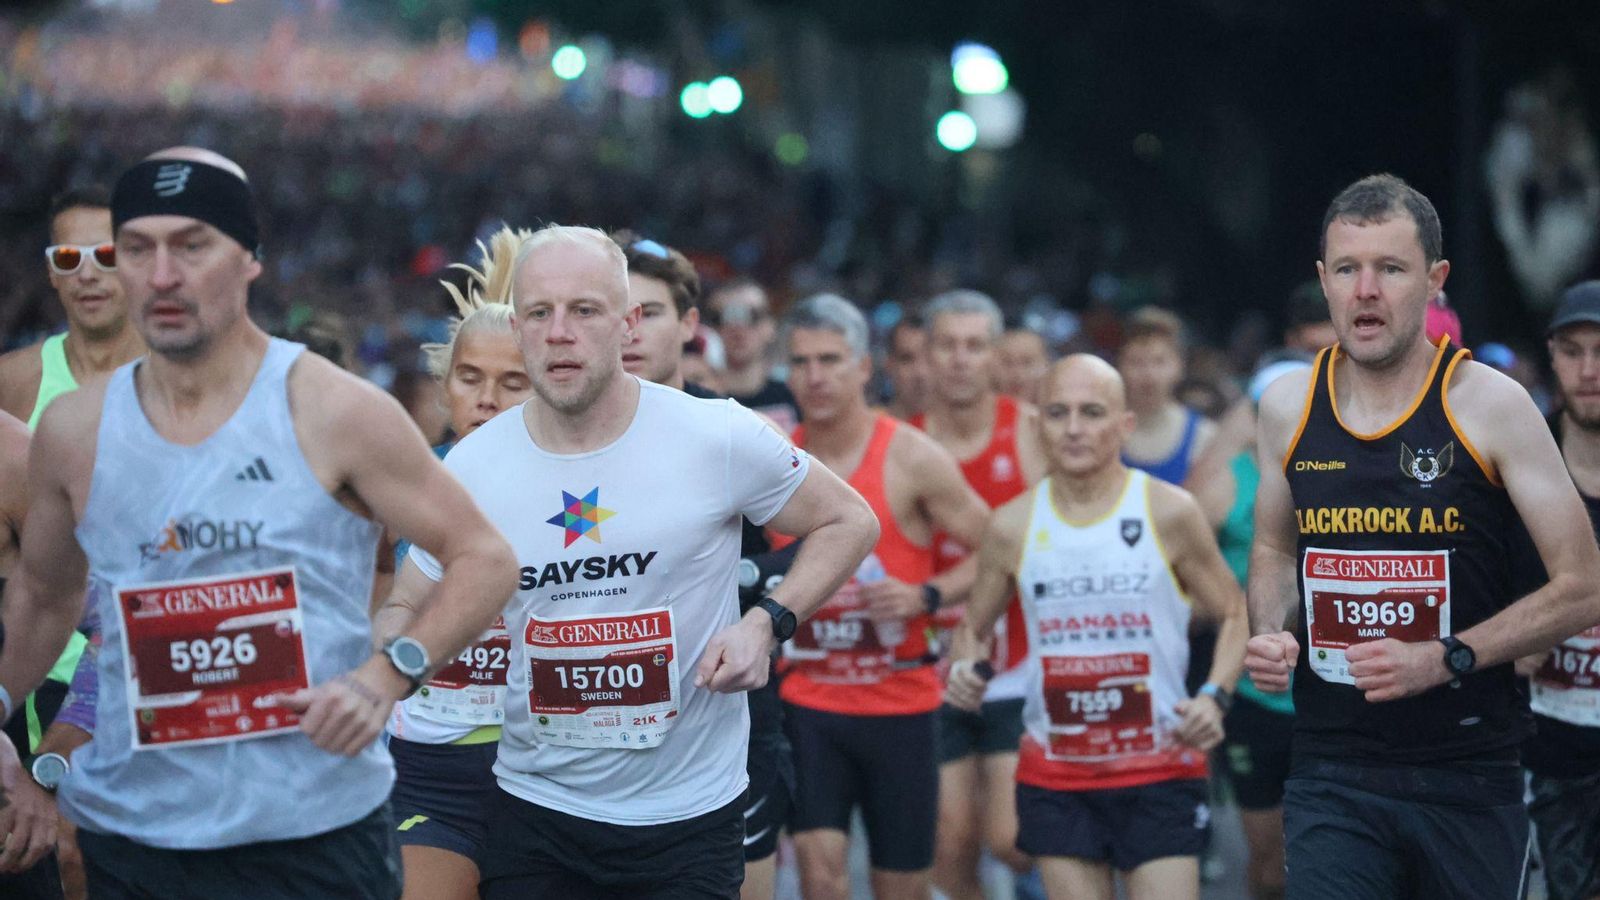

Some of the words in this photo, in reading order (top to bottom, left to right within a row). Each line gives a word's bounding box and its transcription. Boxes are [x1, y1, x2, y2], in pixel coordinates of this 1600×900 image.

[1418, 506, 1466, 534] A.C.
[518, 551, 659, 591] SAYSKY
[1338, 559, 1436, 578] GENERALI
[550, 587, 628, 602] COPENHAGEN
[1333, 599, 1416, 626] 13969
[559, 616, 662, 644] GENERALI
[1357, 628, 1387, 637] MARK
[169, 632, 258, 673] 5926
[448, 646, 512, 670] 492
[192, 667, 241, 685] ROBERT
[469, 671, 494, 680] JULIE
[554, 663, 645, 690] 15700
[580, 691, 623, 701] SWEDEN
[1065, 688, 1123, 714] 7559
[633, 715, 657, 726] 21K
